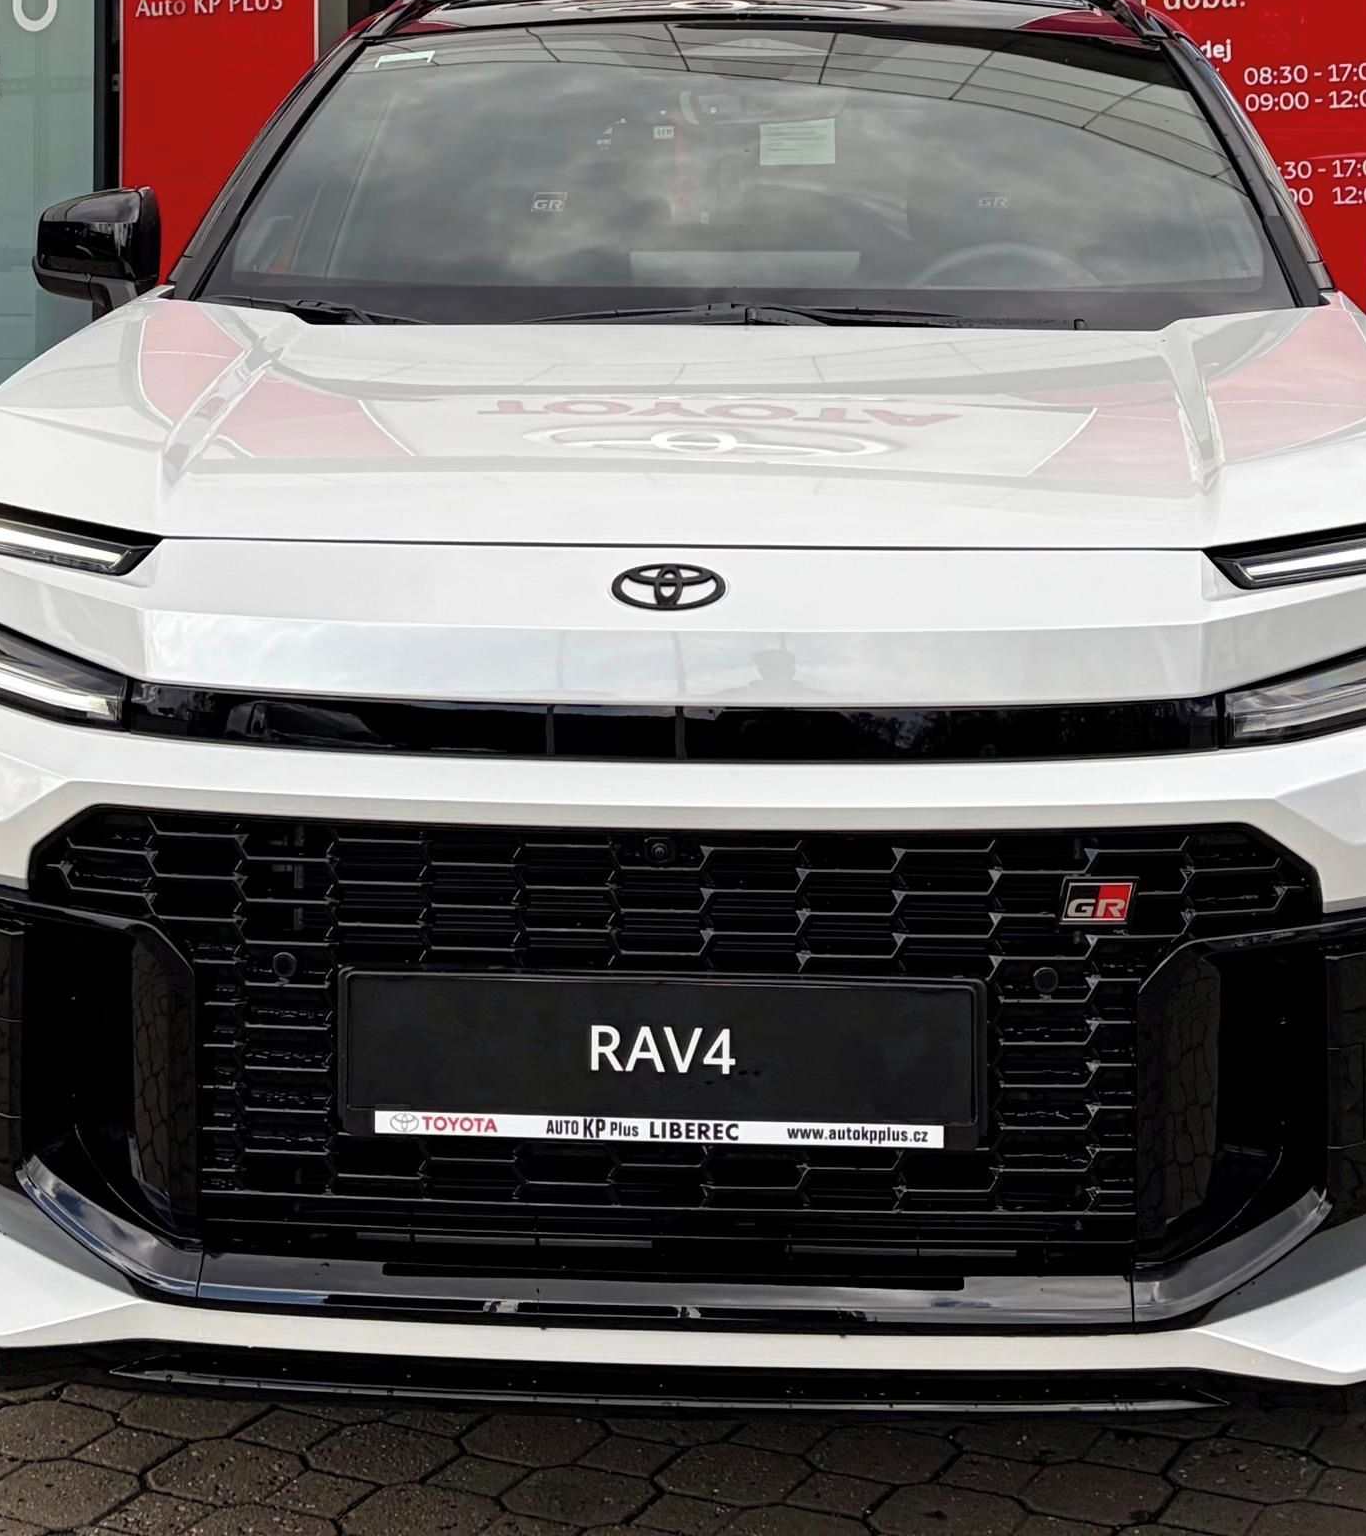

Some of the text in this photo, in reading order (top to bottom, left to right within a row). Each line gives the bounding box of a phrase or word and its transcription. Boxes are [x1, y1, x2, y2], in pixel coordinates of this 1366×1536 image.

[1243, 65, 1309, 86] 08:30
[1245, 91, 1310, 112] 09:00
[534, 199, 565, 209] GR
[1066, 898, 1126, 918] GR
[589, 1024, 736, 1075] RAV4
[421, 1115, 929, 1146] TOYOTA AUTO KP Plus LIBEREC www.autokpplus.cz
